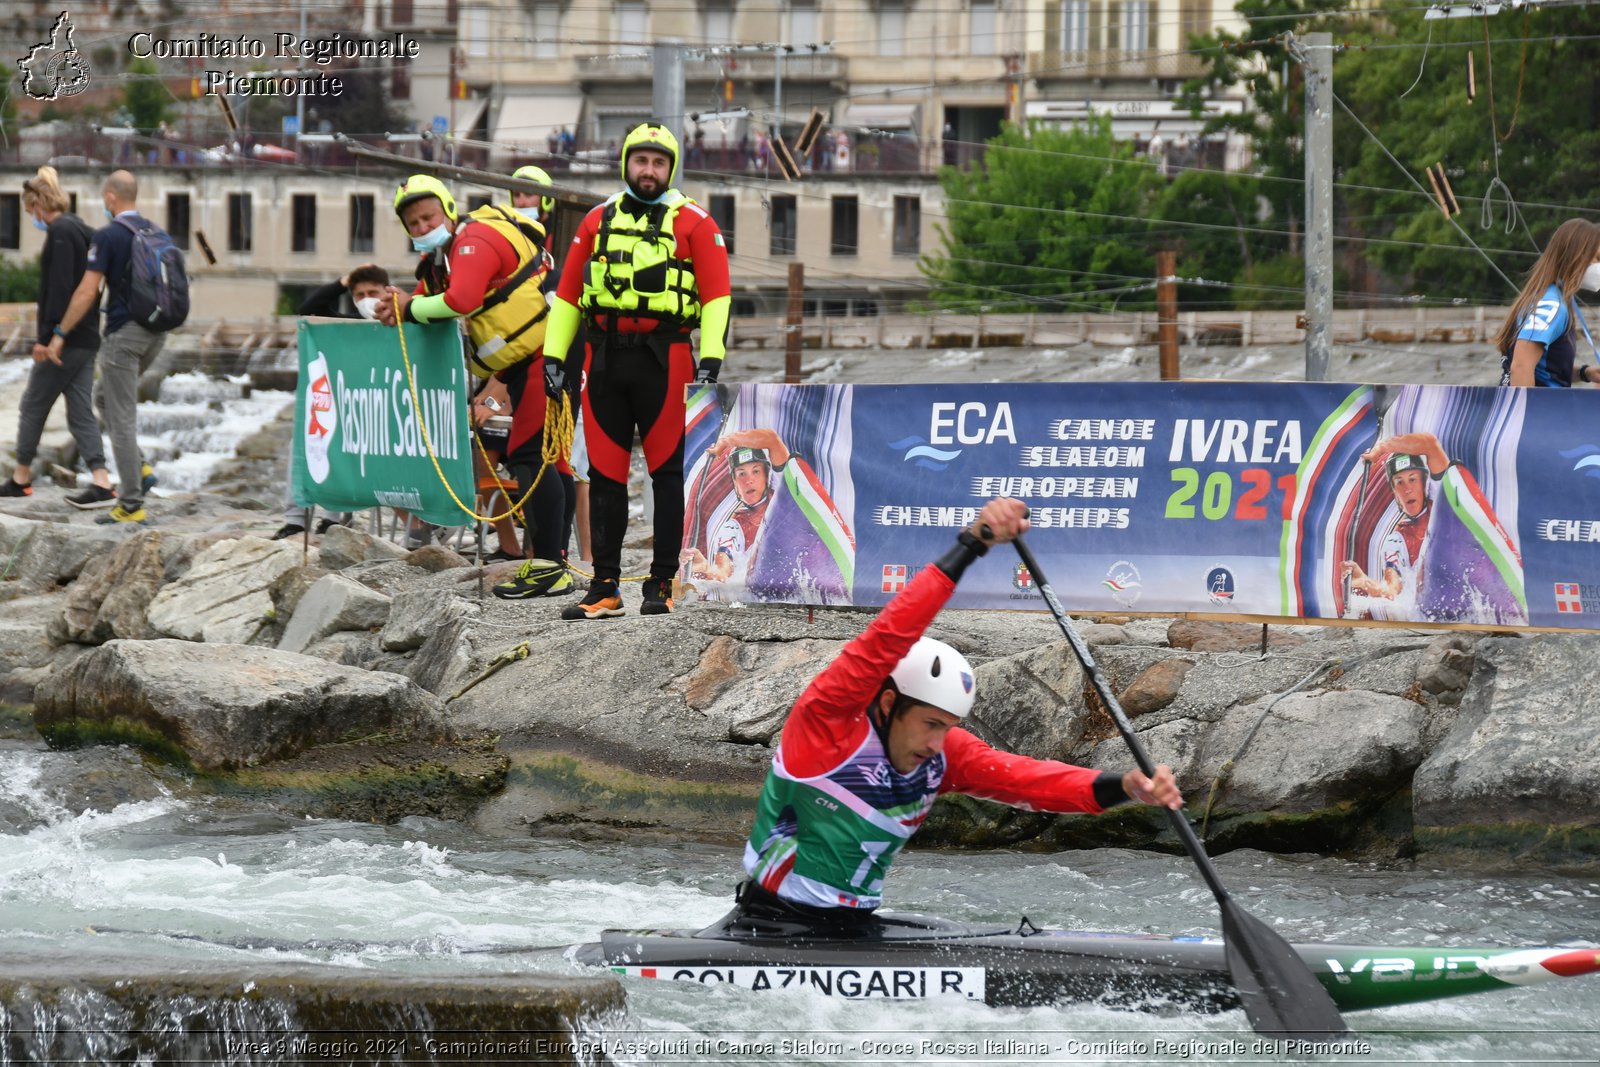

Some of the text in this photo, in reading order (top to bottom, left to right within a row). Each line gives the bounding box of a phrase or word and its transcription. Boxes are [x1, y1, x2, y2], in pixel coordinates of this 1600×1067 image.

[391, 363, 458, 461] Salumi
[930, 402, 1017, 445] ECA
[1054, 418, 1156, 441] CANOE
[1168, 418, 1303, 464] IVREA
[1028, 446, 1146, 468] SLALOM
[979, 476, 1140, 499] EUROPEAN
[1164, 467, 1297, 521] 2021
[879, 504, 1131, 530] CHAMPSHIPS
[941, 970, 974, 998] R.
